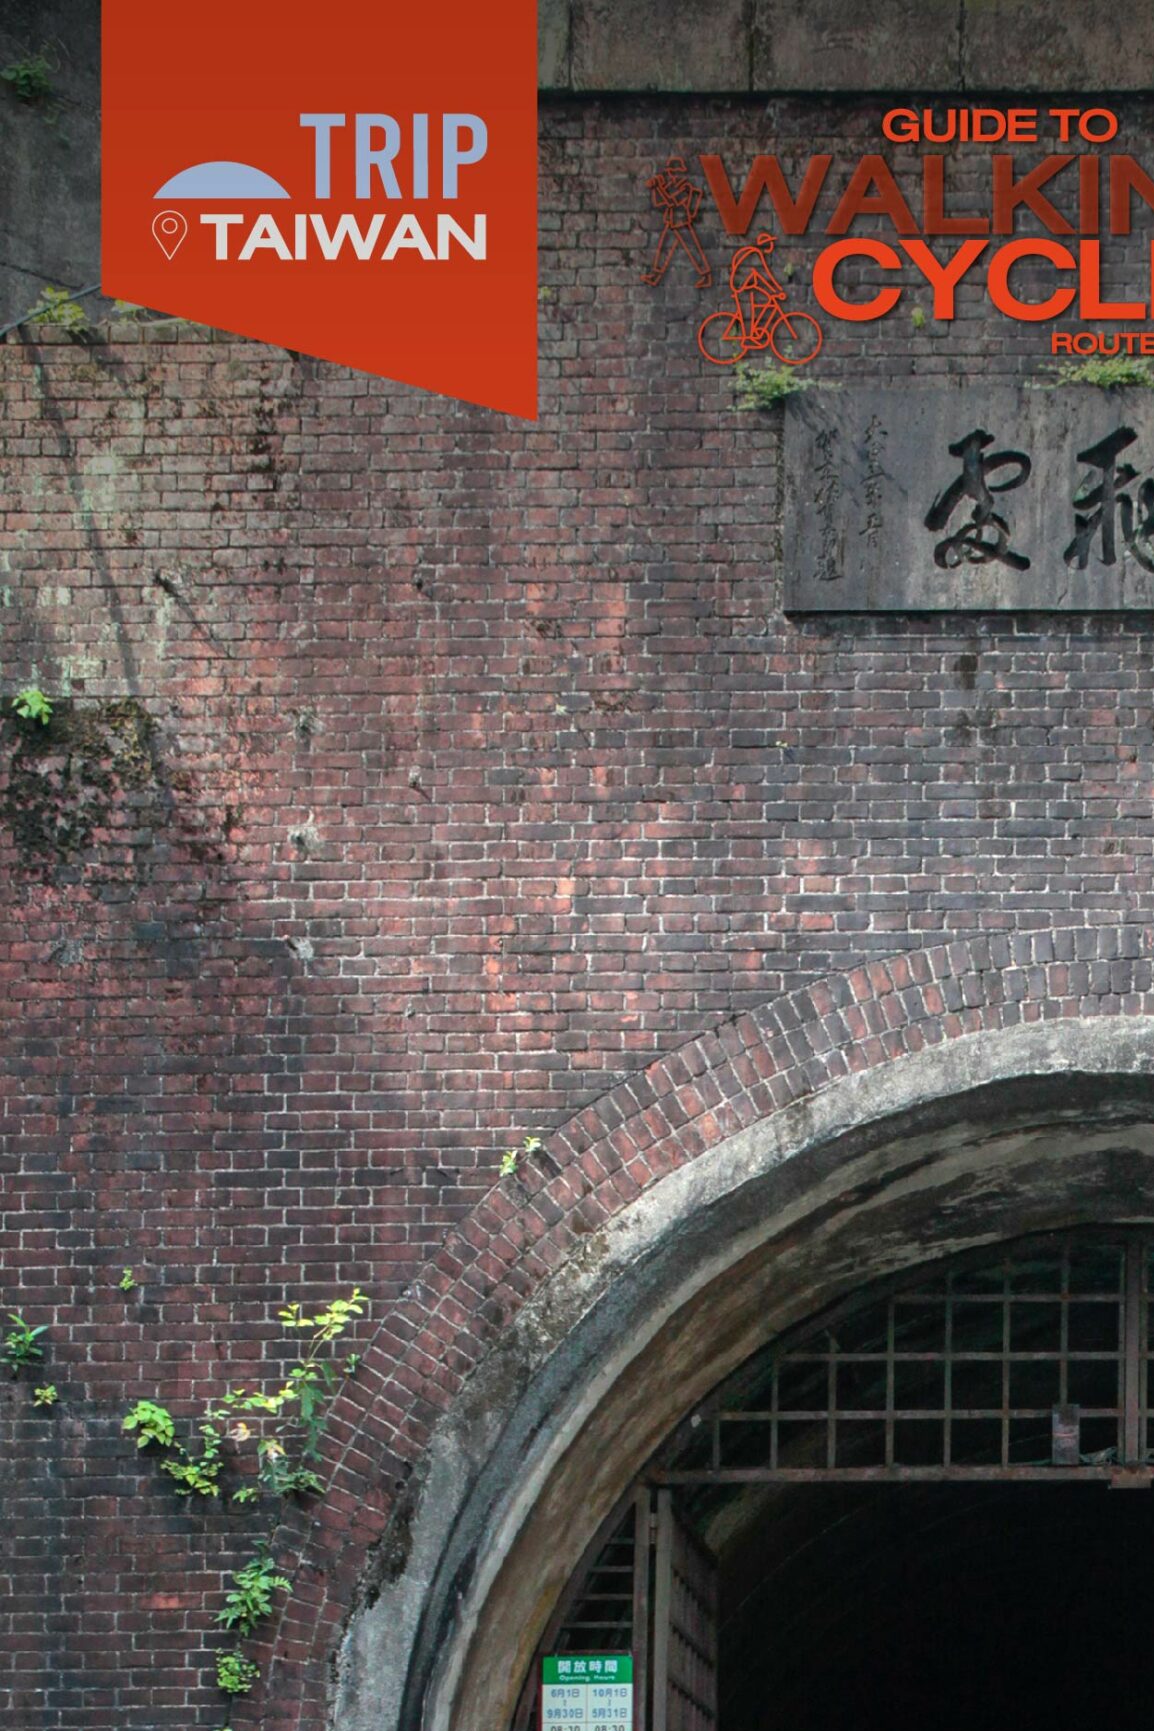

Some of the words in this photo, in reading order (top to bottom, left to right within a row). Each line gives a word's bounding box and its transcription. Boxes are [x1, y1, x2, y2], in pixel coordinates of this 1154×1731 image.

[557, 1660, 618, 1673] 開放時間
[551, 1688, 580, 1698] 6月1日
[592, 1688, 628, 1698] 10月1日
[547, 1708, 584, 1719] 9月30日
[592, 1708, 628, 1719] 5月31日
